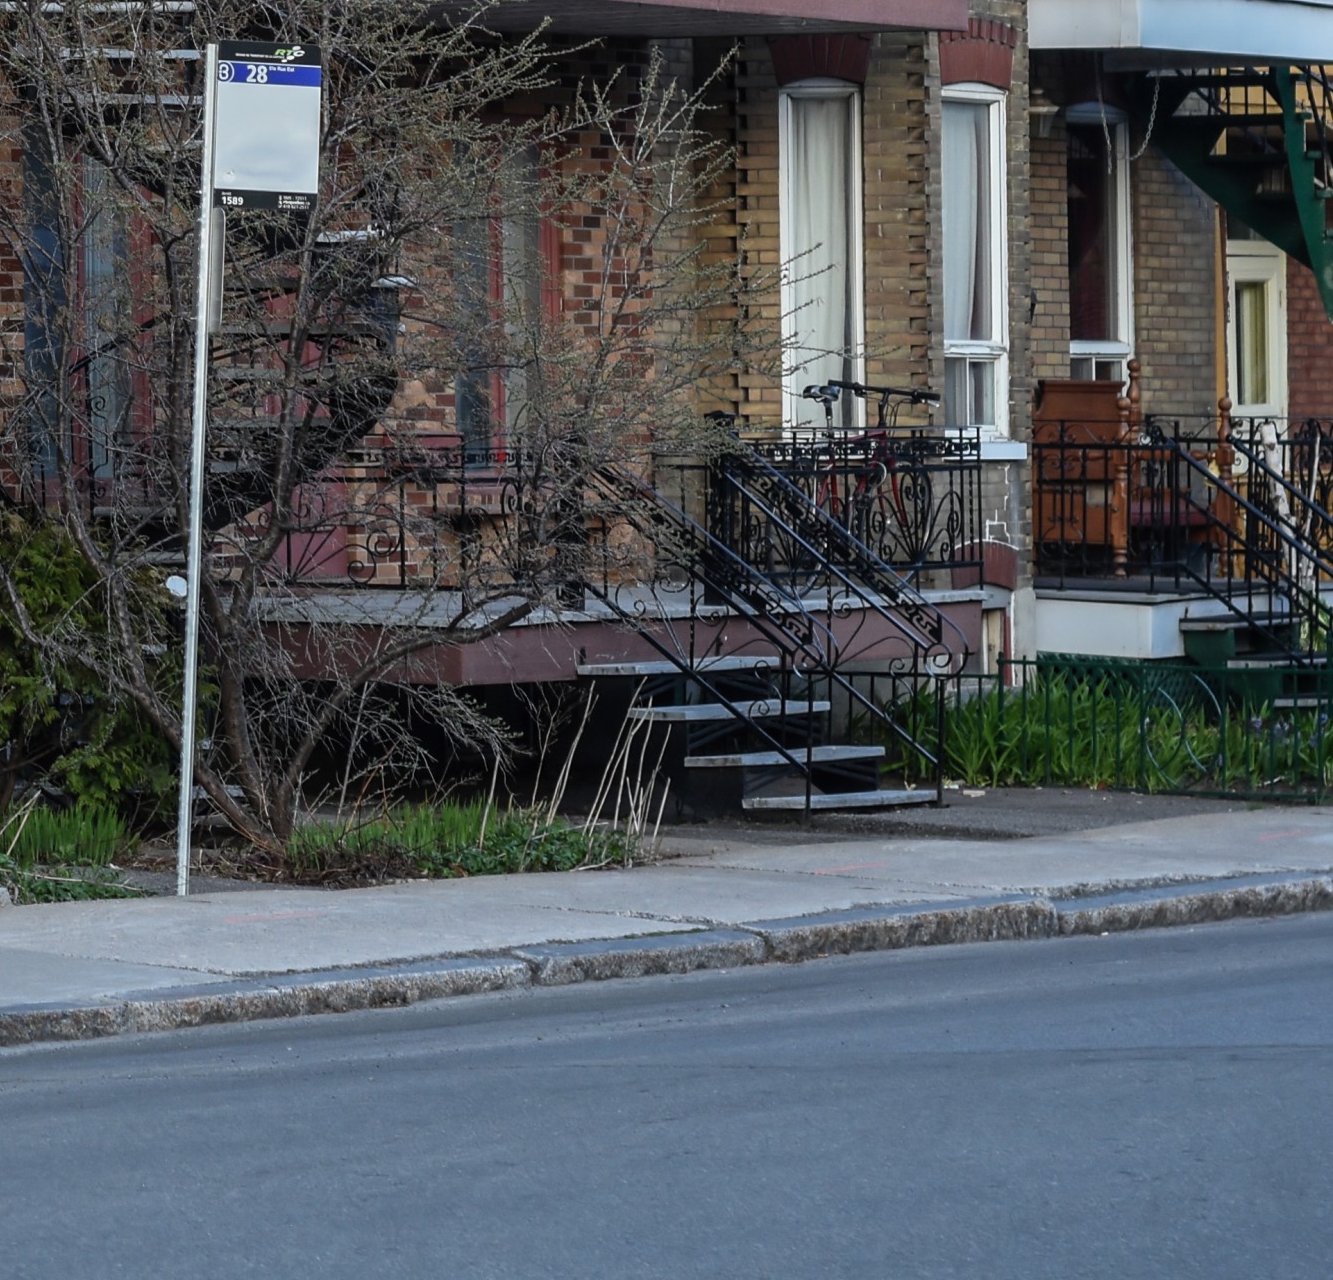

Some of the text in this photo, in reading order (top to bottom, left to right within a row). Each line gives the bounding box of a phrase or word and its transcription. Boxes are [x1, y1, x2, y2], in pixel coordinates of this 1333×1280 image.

[274, 48, 305, 58] RTC
[246, 64, 268, 83] 28
[221, 196, 244, 206] 1589
